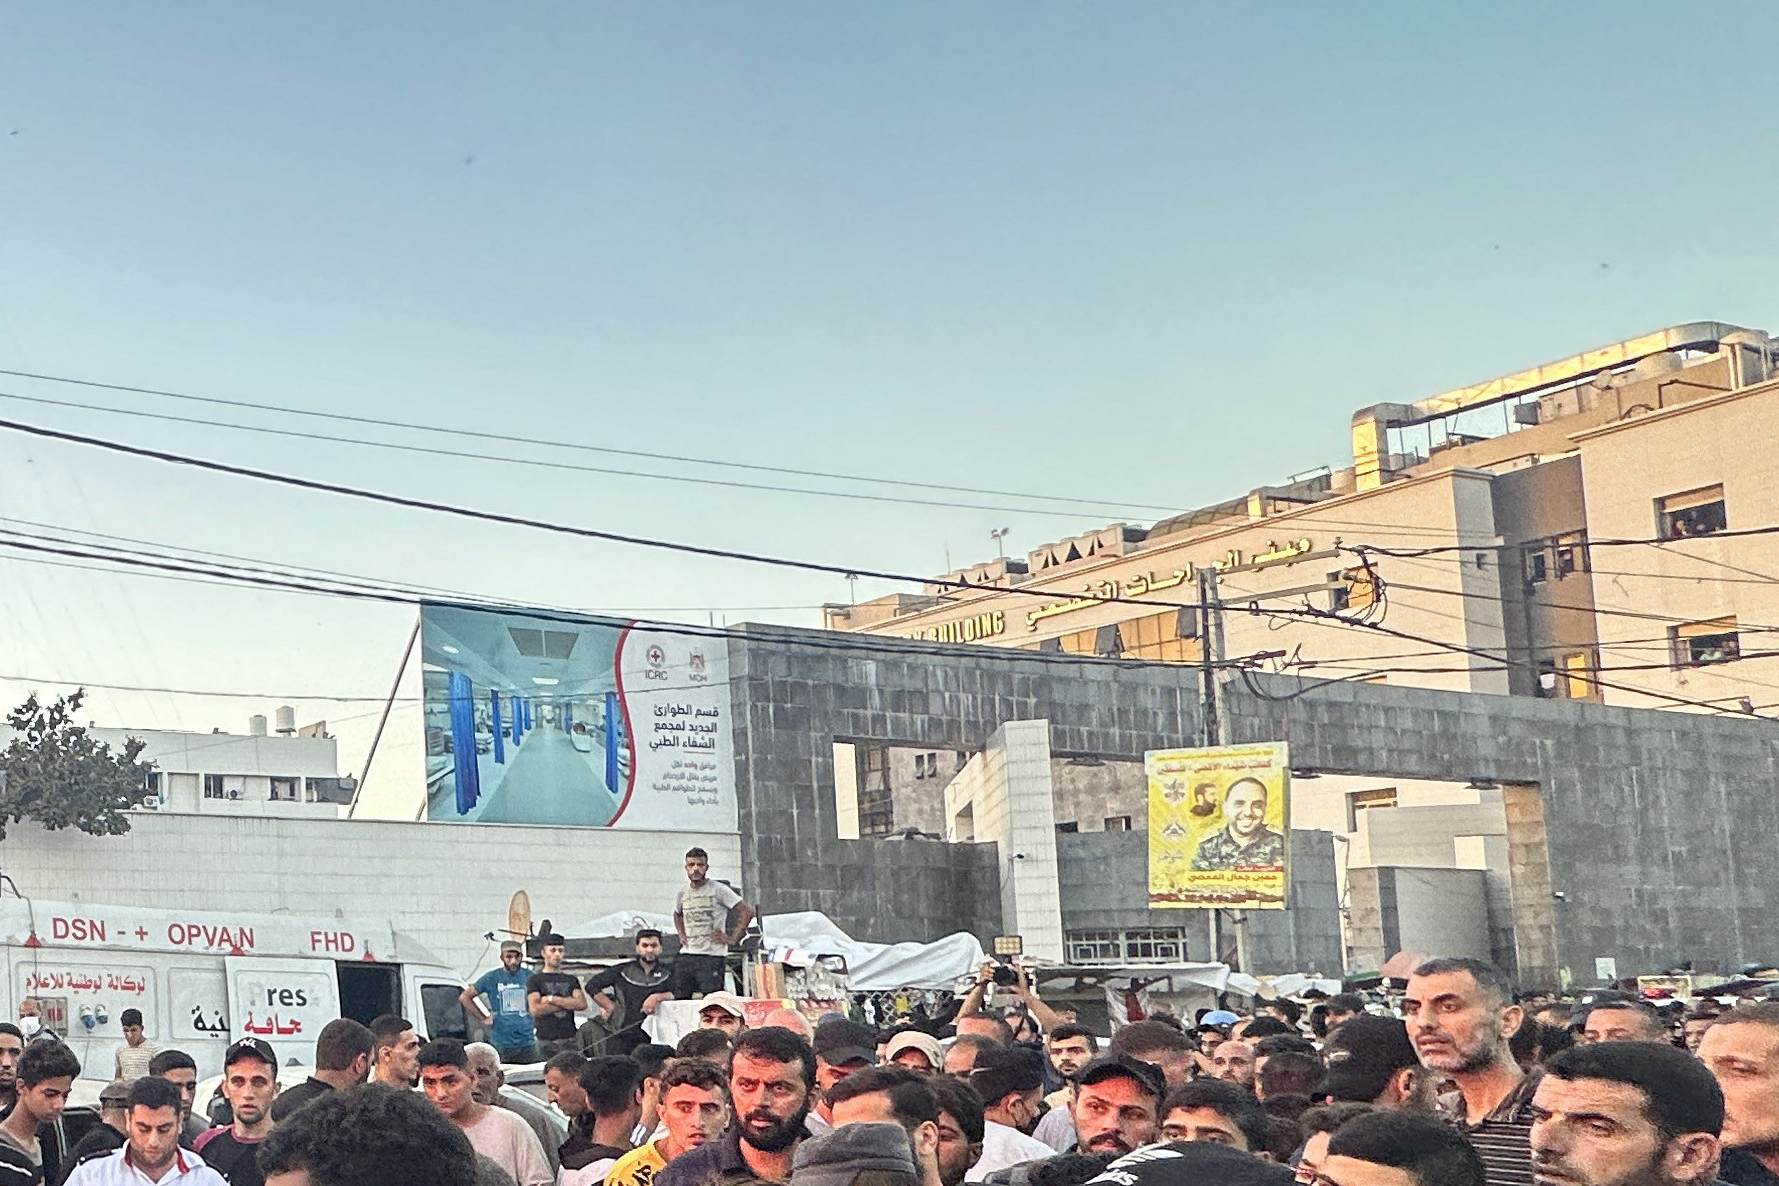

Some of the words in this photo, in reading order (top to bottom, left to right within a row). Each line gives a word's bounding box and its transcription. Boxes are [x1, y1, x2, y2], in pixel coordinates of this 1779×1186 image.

[927, 610, 1005, 643] BUILDING
[645, 669, 668, 681] ICRC
[653, 702, 692, 718] الطوارئ
[695, 707, 719, 718] قسم
[653, 720, 685, 733] لمجمع
[689, 722, 717, 735] الجديد
[649, 735, 679, 752] الطبي
[682, 735, 715, 749] الشفاء
[52, 917, 106, 942] DSN
[168, 923, 255, 949] OPVAN
[310, 931, 355, 952] FHD
